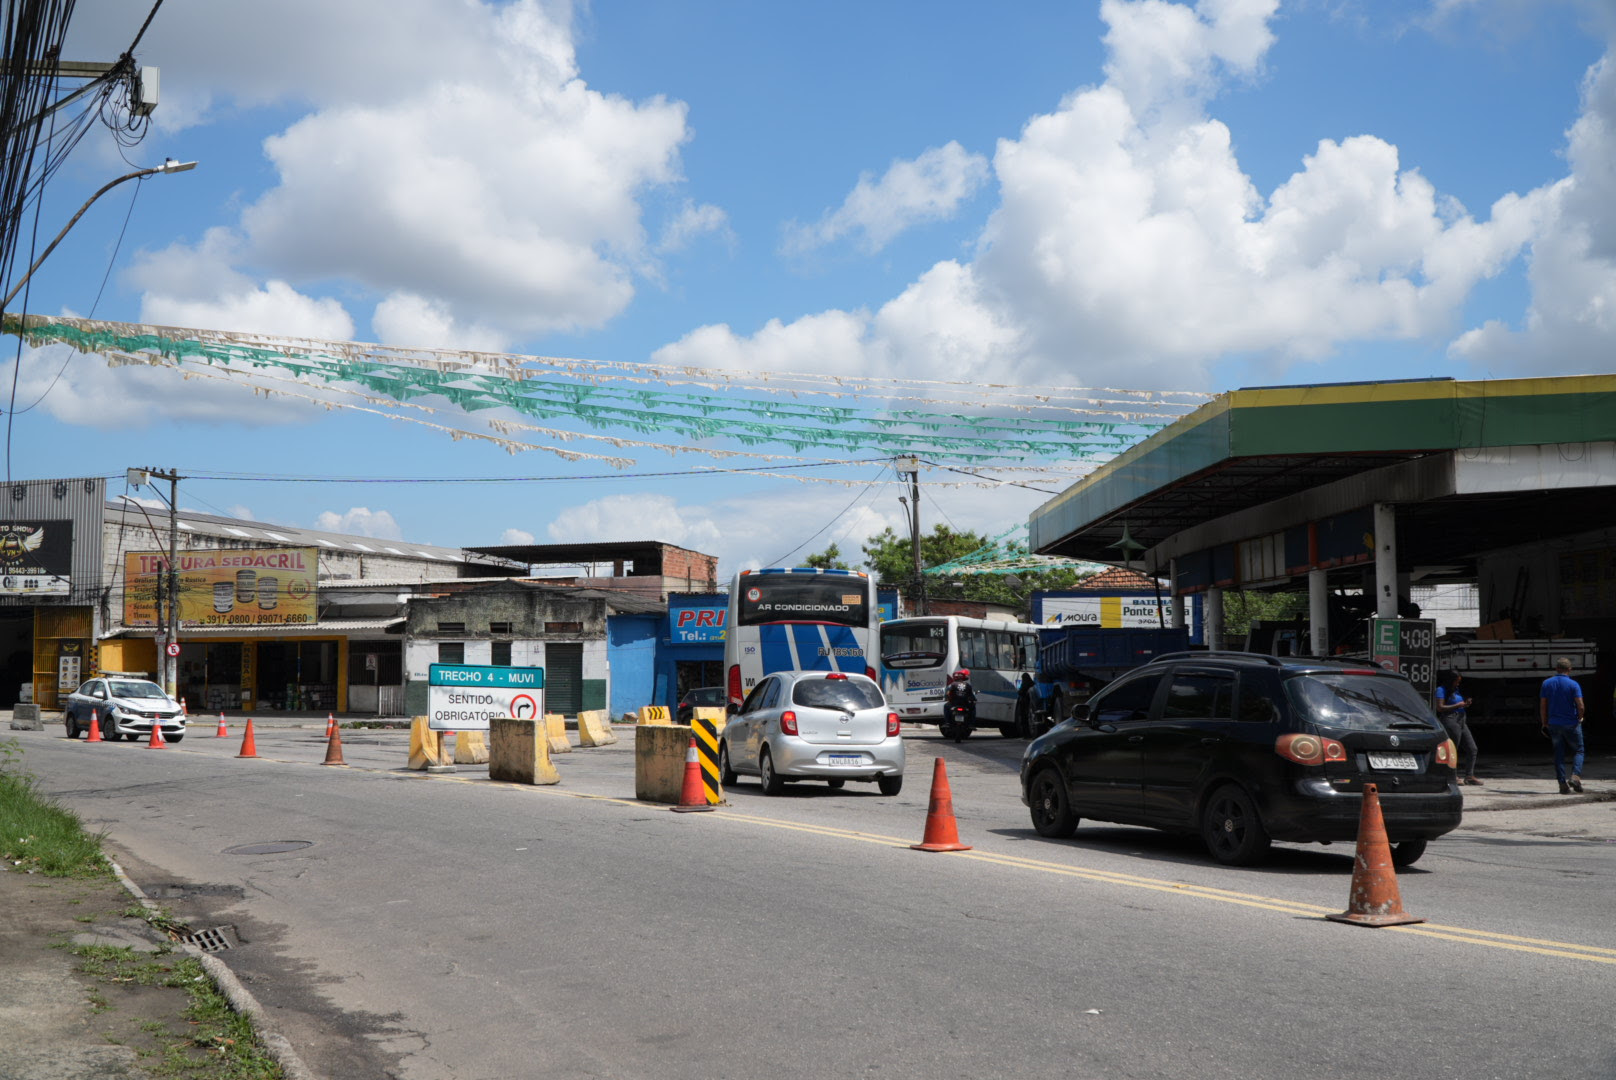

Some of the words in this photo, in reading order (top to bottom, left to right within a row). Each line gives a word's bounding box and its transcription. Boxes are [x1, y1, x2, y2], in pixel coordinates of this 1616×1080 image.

[12, 525, 35, 533] SHOW
[140, 556, 216, 573] TEXURA
[222, 552, 305, 569] SEDACRIL
[758, 603, 772, 611] AR
[774, 603, 850, 612] CONDICIONADO
[1123, 606, 1154, 616] Ponte
[206, 615, 250, 624] 3917-0800
[257, 614, 308, 623] 99071-6660
[677, 609, 728, 628] PRI
[1381, 624, 1394, 645] E
[439, 670, 481, 682] TRECHO
[487, 673, 494, 682] 4
[508, 673, 535, 683] MUVI
[448, 694, 493, 705] SENTIDO
[435, 709, 506, 721] OBRIGATÓRIO
